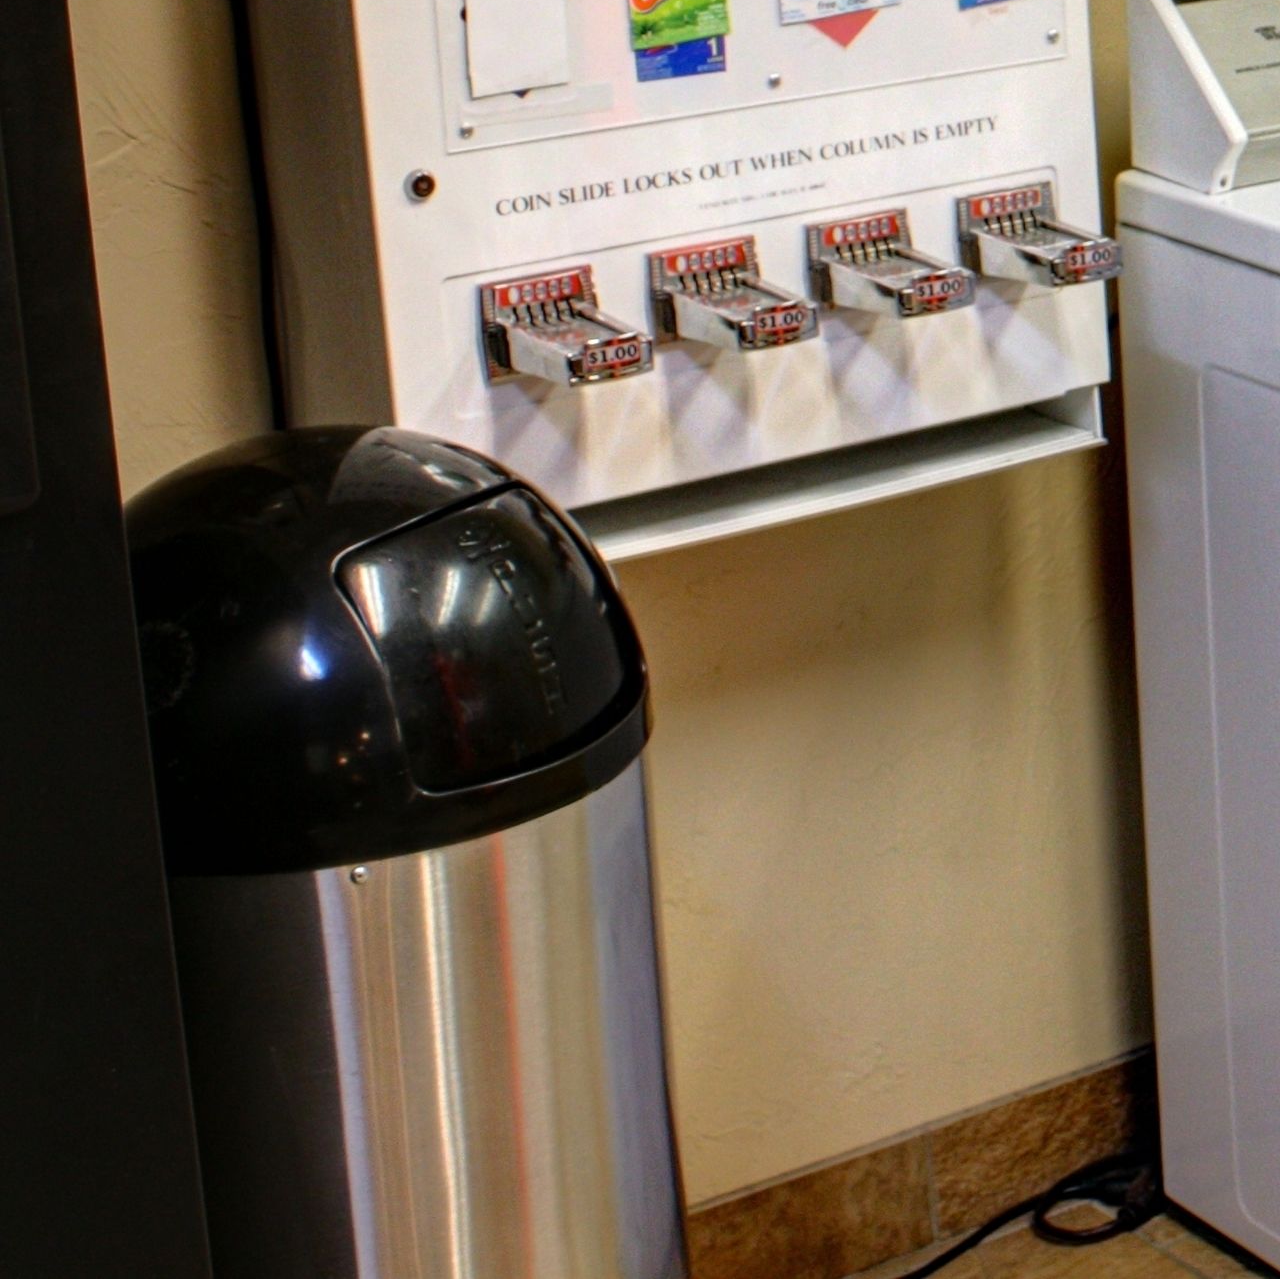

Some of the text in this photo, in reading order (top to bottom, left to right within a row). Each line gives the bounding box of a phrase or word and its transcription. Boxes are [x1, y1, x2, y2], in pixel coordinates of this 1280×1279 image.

[495, 114, 999, 217] COIN SLIDE LOCKS OUT WHEN COLUMN IS EMPTY
[1070, 247, 1111, 267] $1.00
[917, 279, 961, 299] $1.00
[757, 309, 805, 330] $1.00
[587, 344, 639, 366] $1.00
